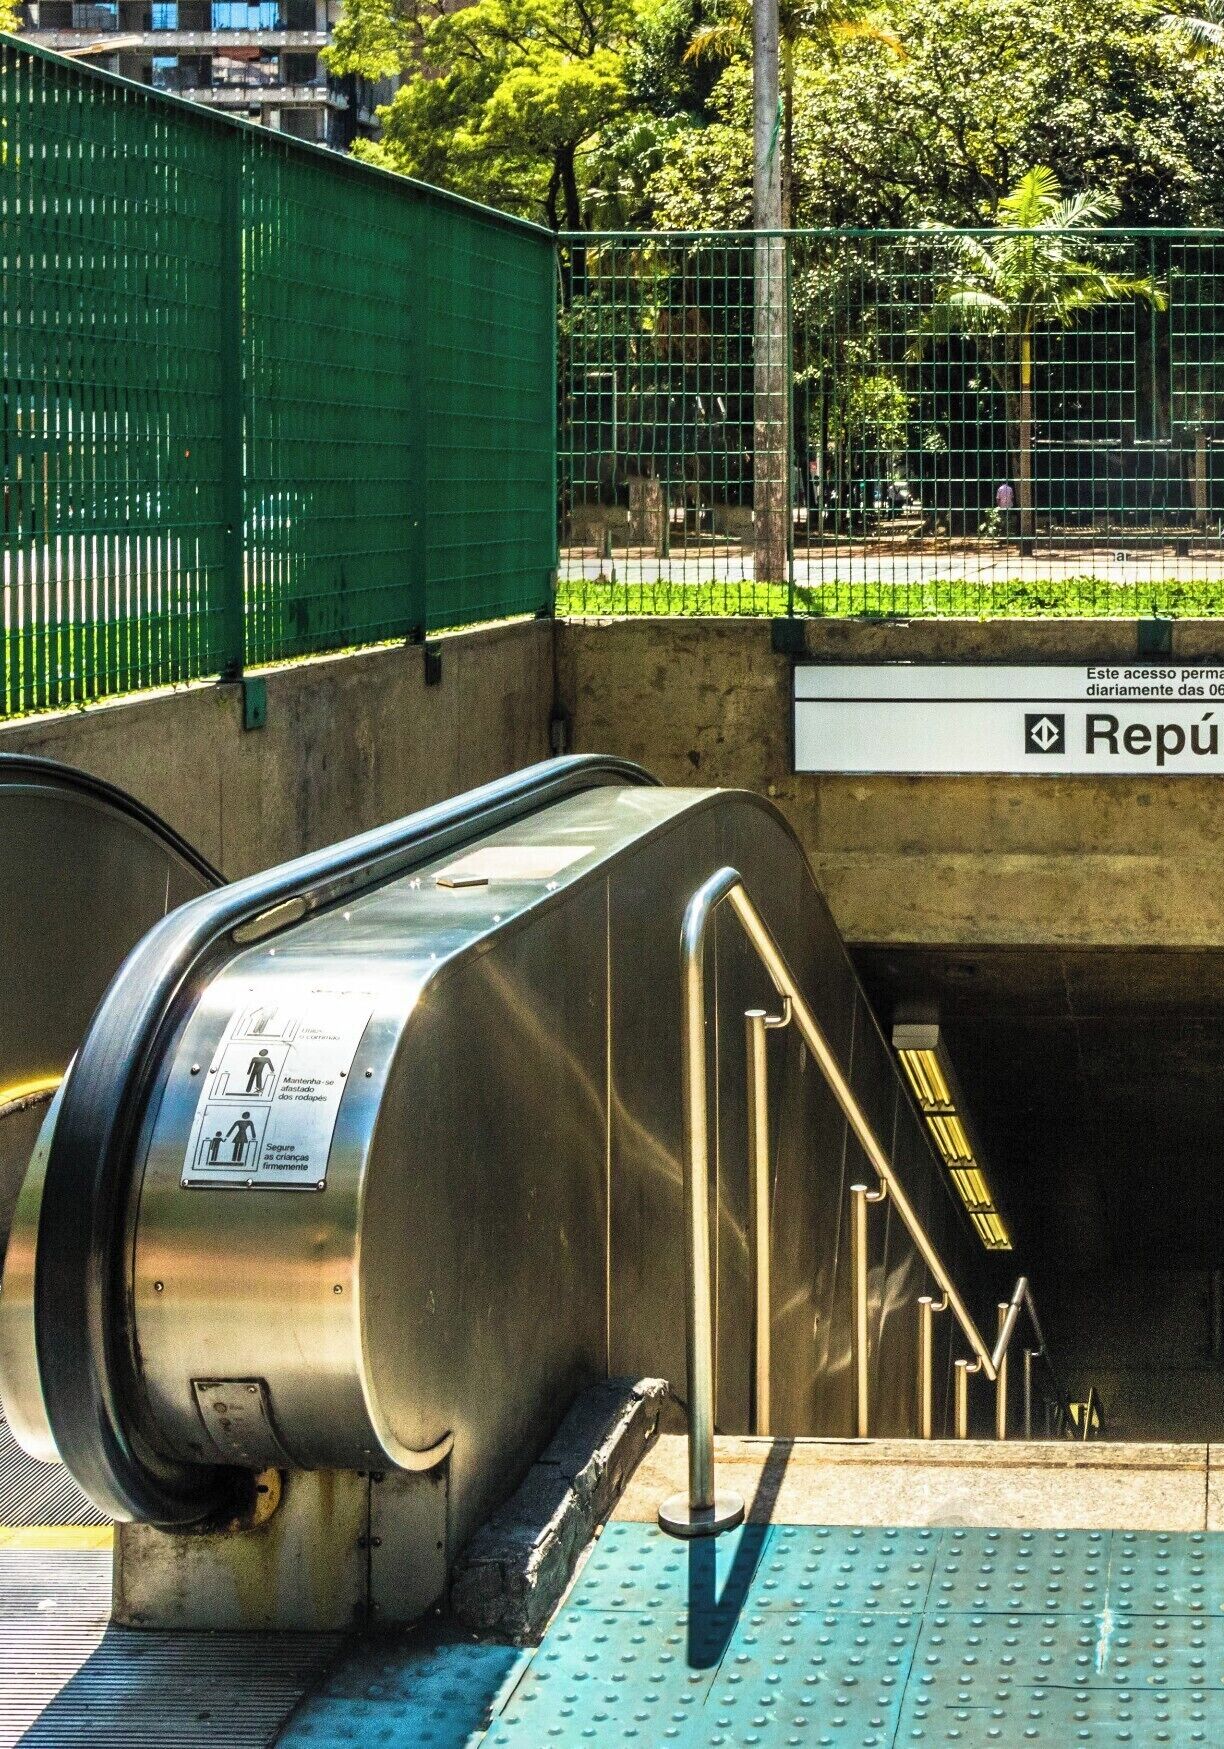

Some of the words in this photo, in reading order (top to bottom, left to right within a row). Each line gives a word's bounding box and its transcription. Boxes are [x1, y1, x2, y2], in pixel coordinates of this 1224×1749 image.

[1086, 667, 1120, 680] Este
[1124, 669, 1177, 680] acesso
[1086, 684, 1174, 697] diariamente
[1178, 684, 1205, 697] das
[283, 1076, 335, 1087] Mantenha-se
[280, 1085, 315, 1094] afastado
[278, 1093, 293, 1101] dos
[294, 1093, 328, 1103] rodapés
[265, 1143, 296, 1154] Segure
[275, 1153, 310, 1163] crianças
[262, 1163, 309, 1171] firmemente
